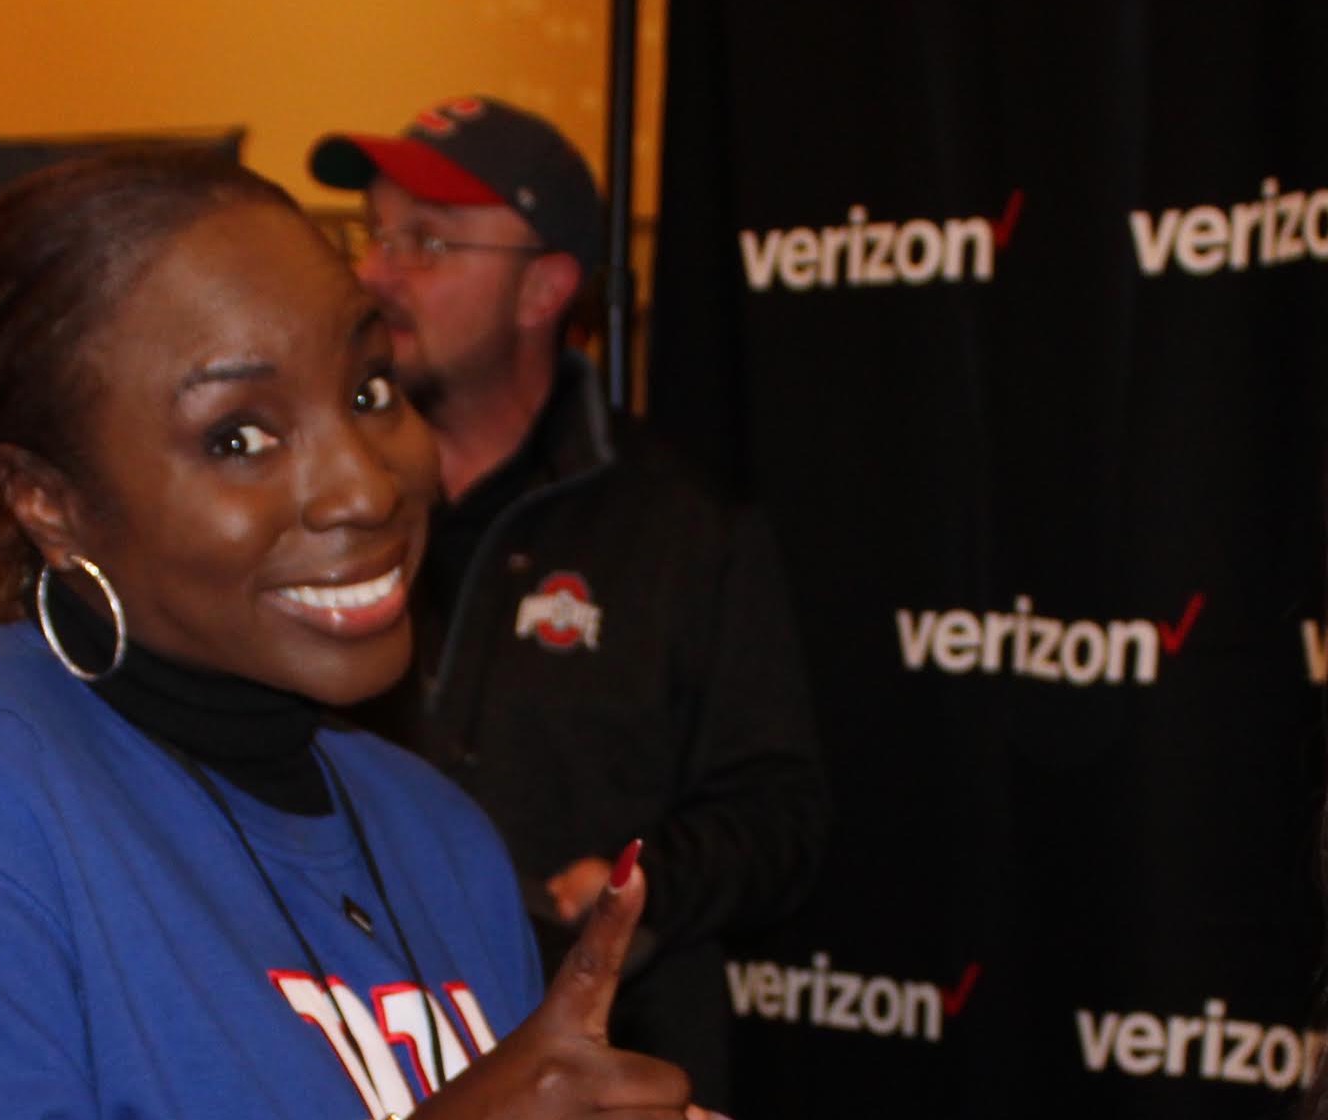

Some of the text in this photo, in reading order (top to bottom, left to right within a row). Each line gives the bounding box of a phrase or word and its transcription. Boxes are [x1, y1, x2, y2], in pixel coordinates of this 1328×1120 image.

[739, 204, 995, 292] verizon
[896, 595, 1160, 686] verizon
[726, 953, 942, 1041] verizon
